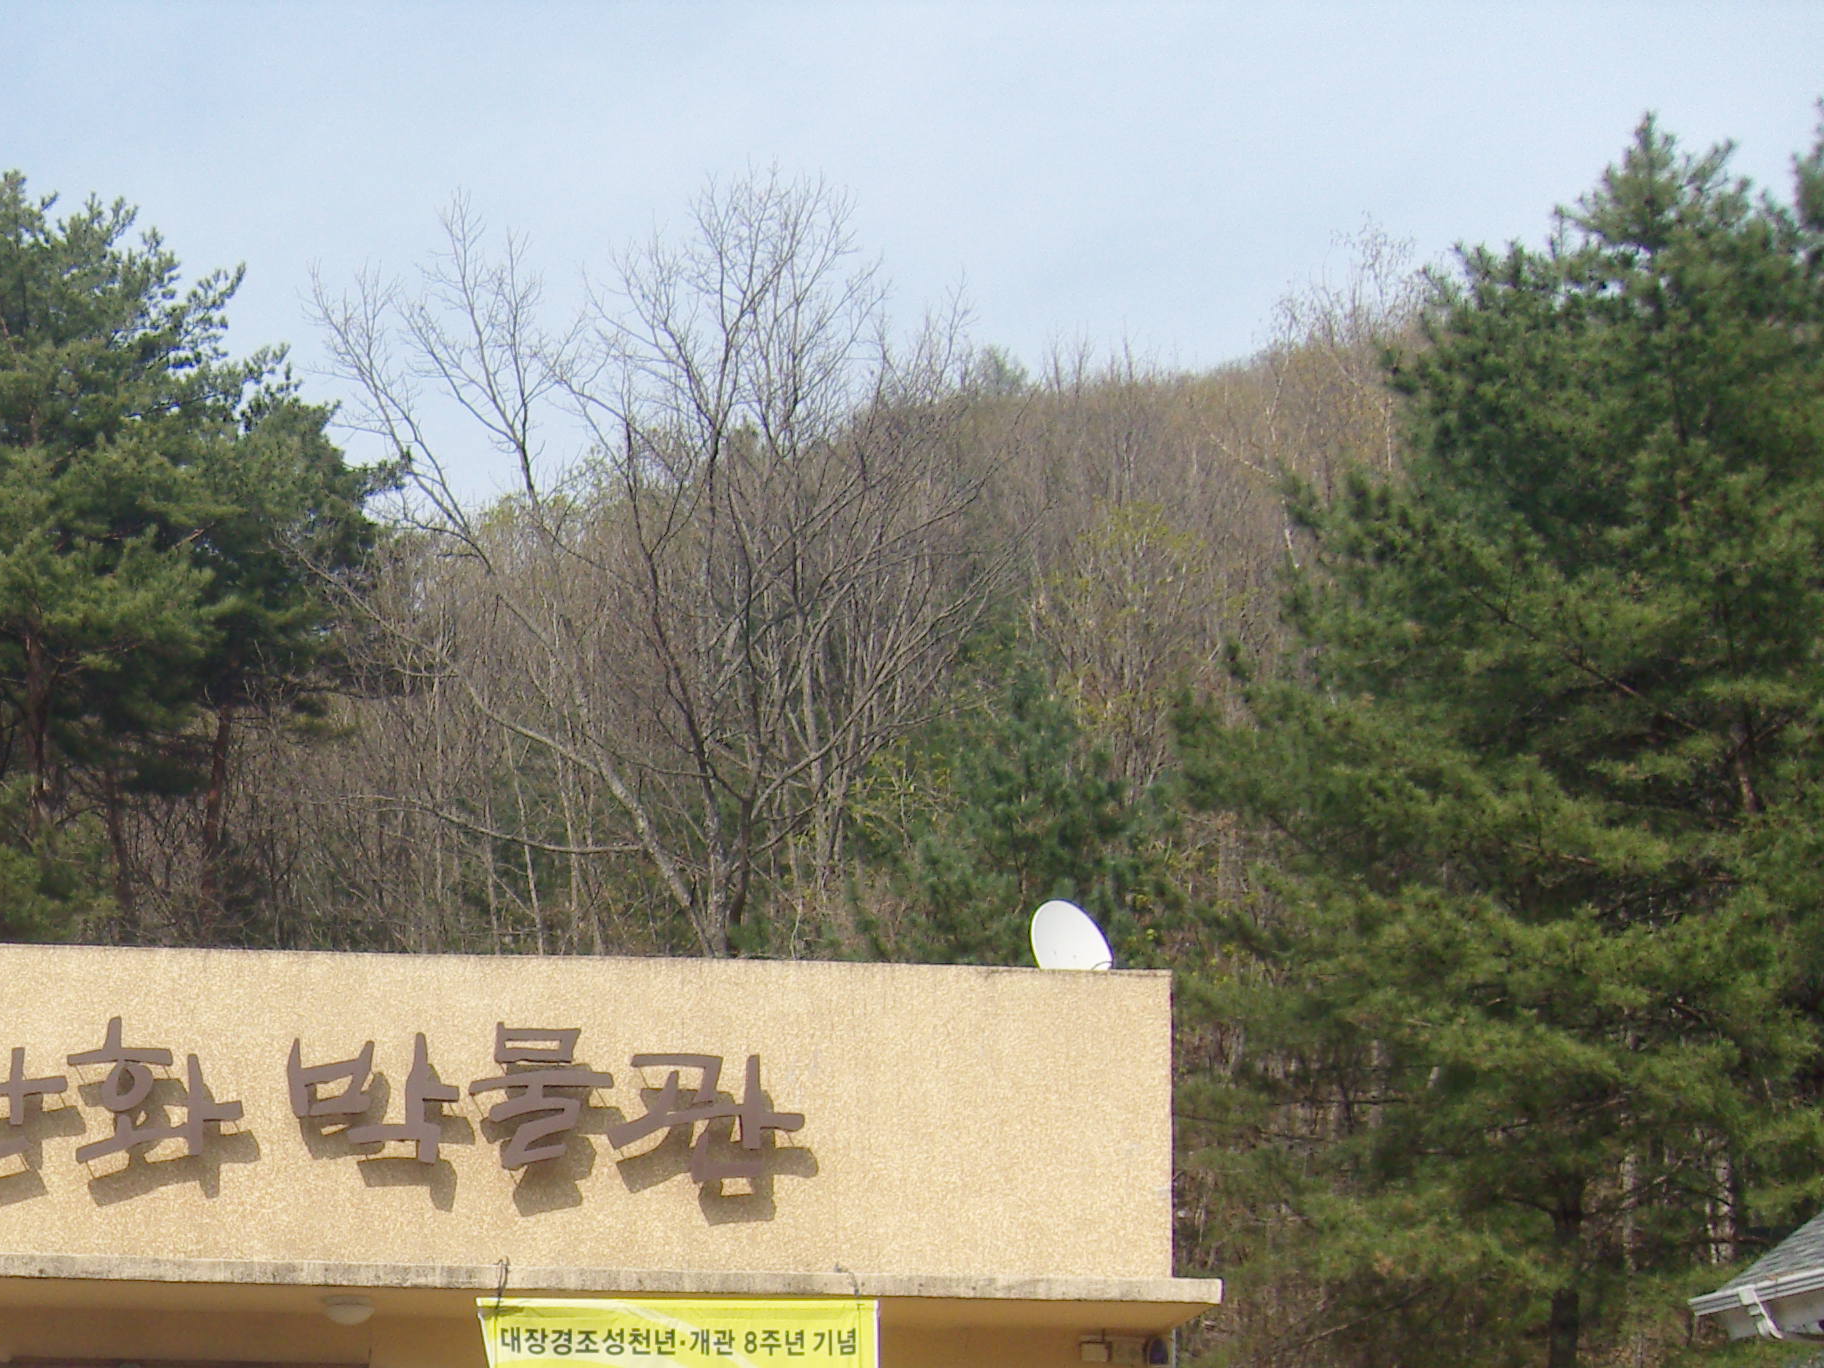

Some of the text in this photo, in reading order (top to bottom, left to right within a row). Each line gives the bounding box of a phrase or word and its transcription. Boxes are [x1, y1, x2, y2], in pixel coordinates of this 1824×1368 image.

[287, 1021, 804, 1182] 박물관
[744, 1329, 806, 1357] 8주년
[813, 1327, 858, 1357] 기념
